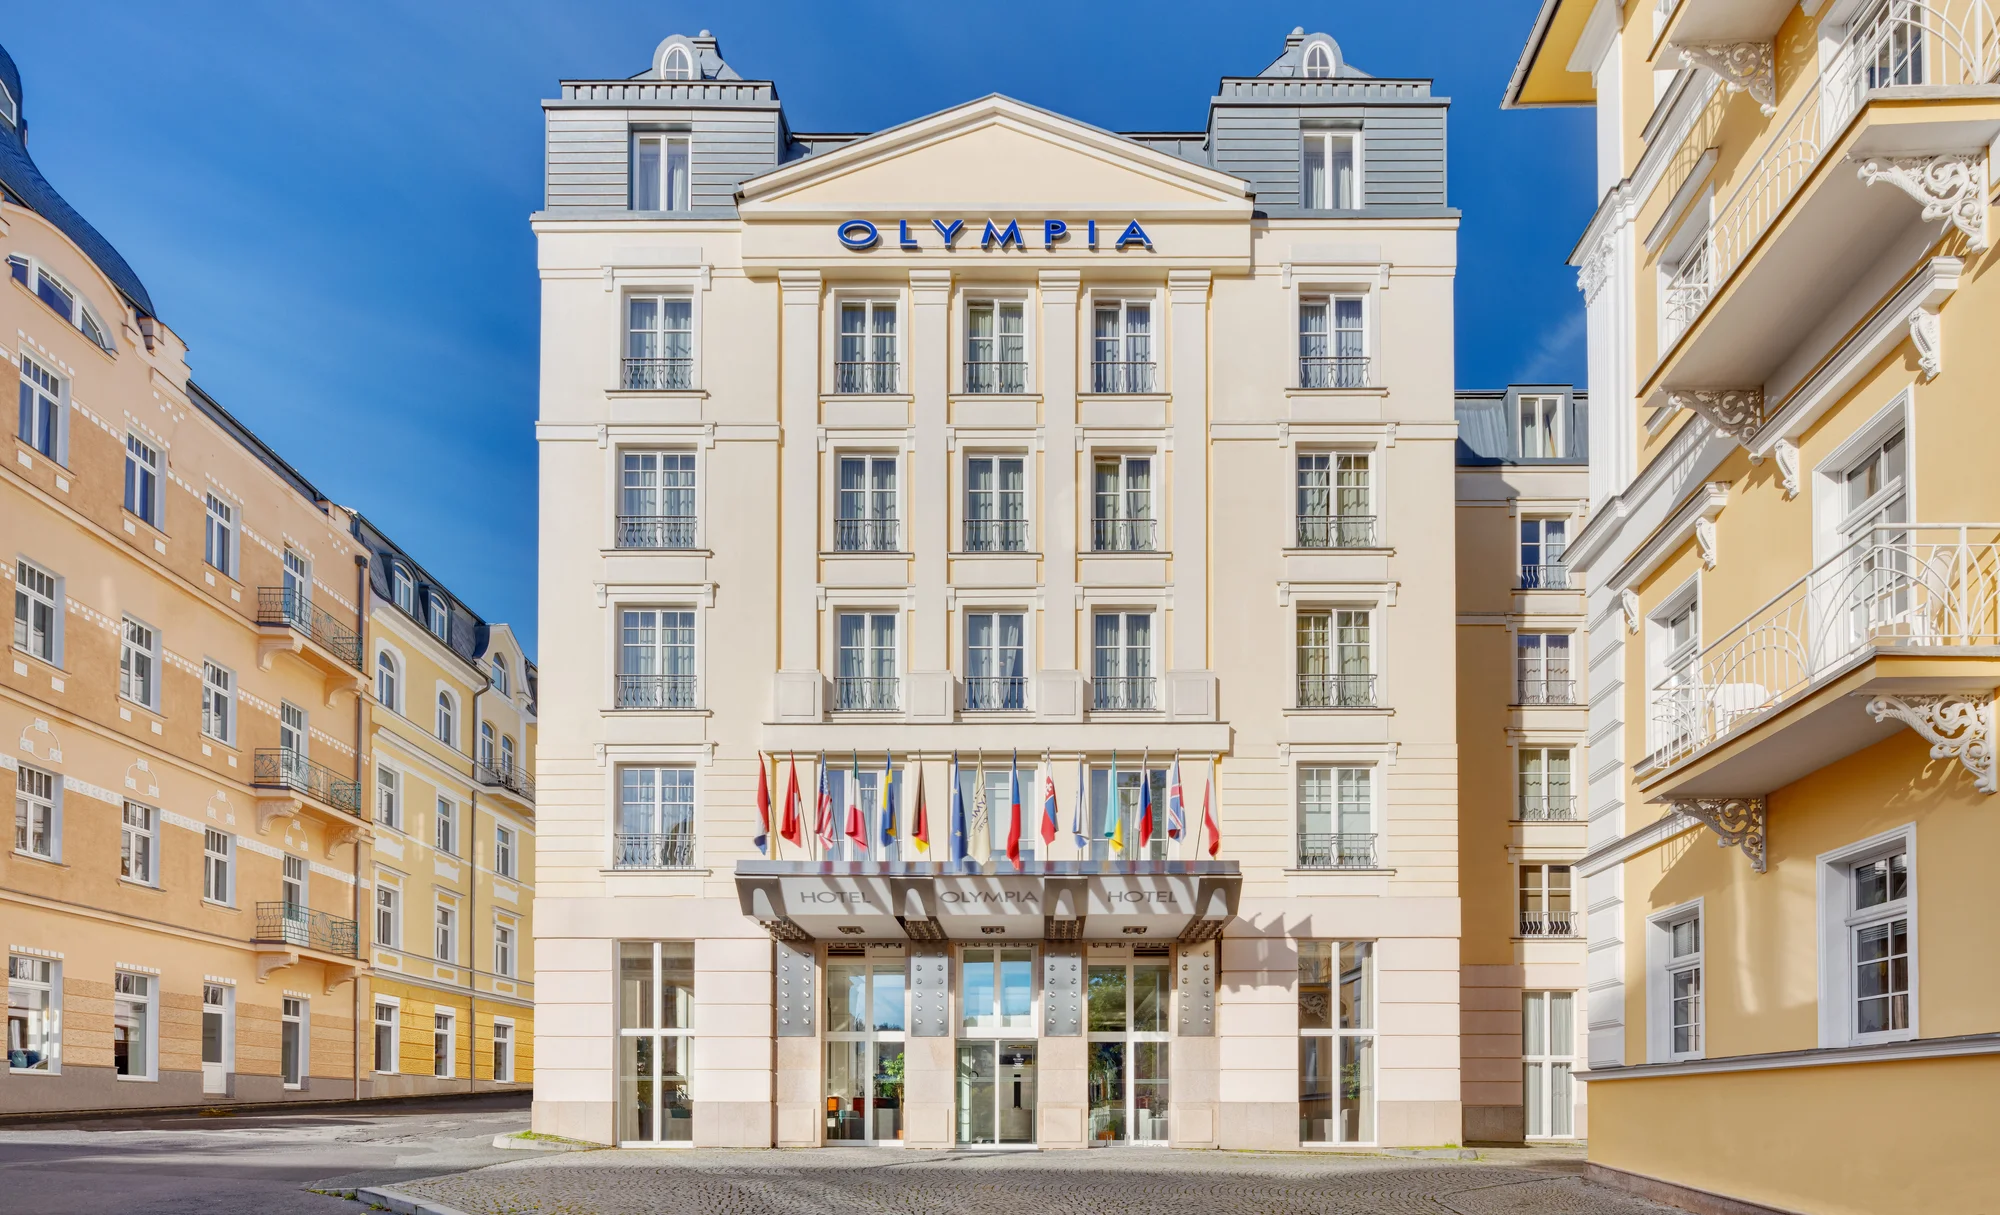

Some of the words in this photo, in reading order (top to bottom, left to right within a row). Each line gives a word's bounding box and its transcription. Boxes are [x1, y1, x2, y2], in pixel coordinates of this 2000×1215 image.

[837, 218, 1153, 250] OLYMPIA
[800, 891, 871, 903] HOTEL
[940, 891, 1039, 903] OLYMPIA
[1107, 891, 1177, 903] HOTEL
